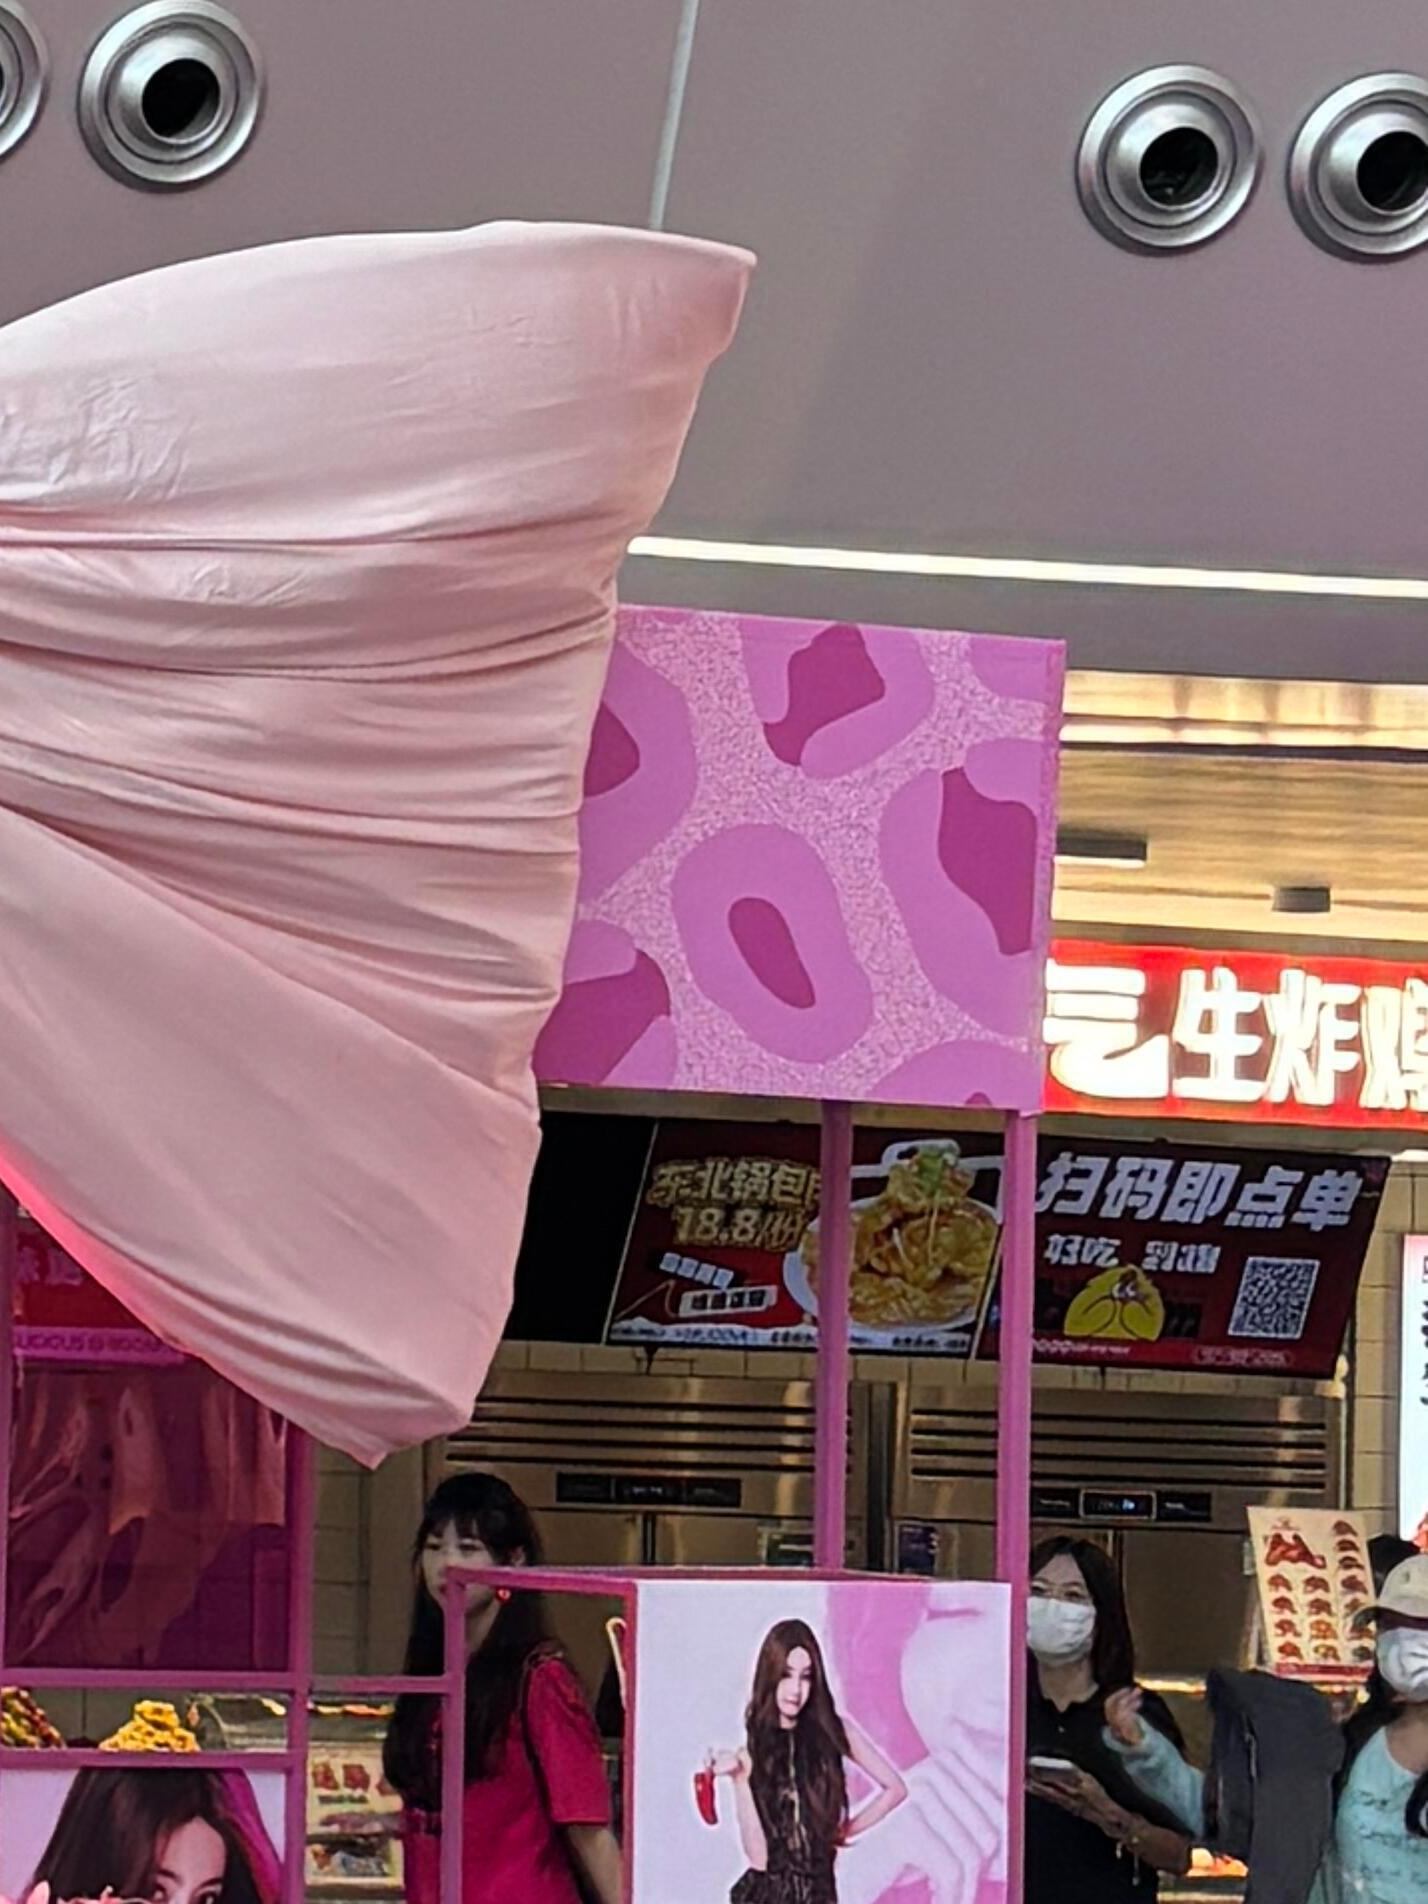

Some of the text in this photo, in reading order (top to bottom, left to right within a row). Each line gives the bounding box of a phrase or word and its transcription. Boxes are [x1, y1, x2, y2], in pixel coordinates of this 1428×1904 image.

[1034, 1151, 1363, 1232] 扫码即点单
